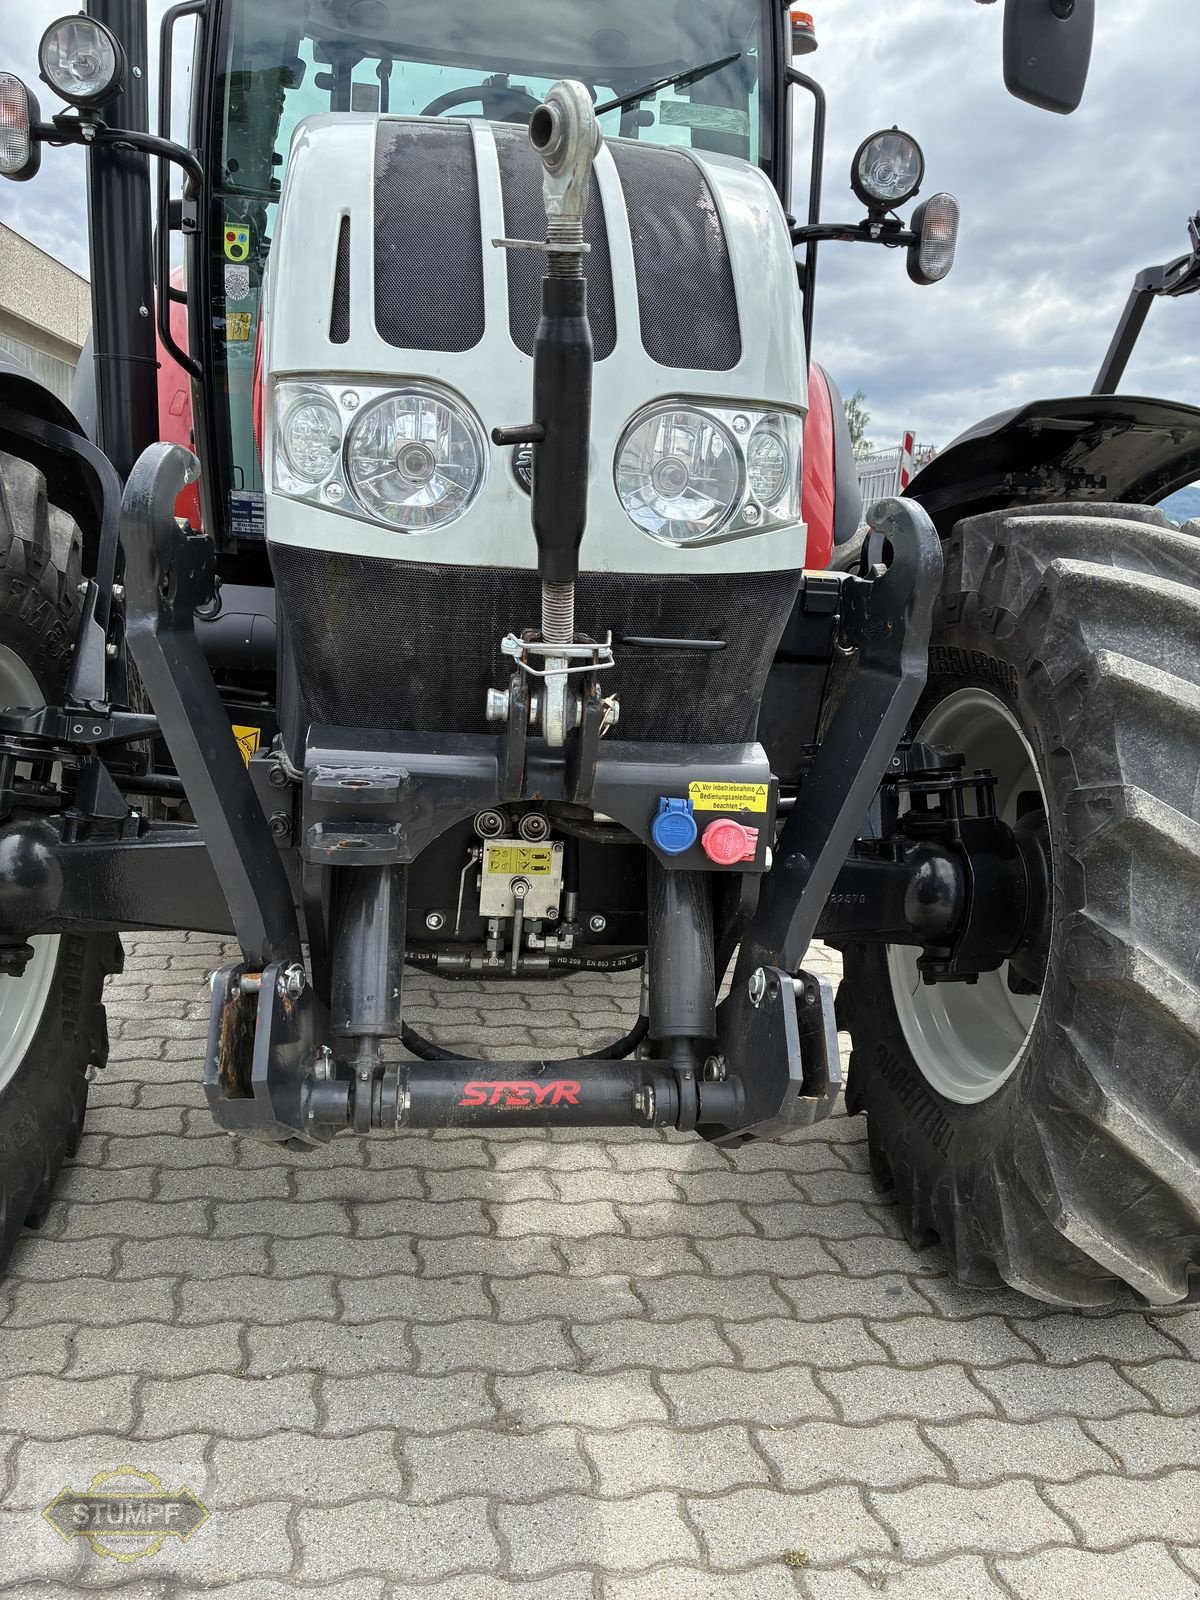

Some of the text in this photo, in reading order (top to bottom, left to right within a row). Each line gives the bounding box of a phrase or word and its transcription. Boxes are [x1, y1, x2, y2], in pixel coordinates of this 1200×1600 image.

[700, 793, 756, 802] Bedienungsanleitung
[586, 959, 596, 967] EN
[458, 1080, 581, 1106] STEYR
